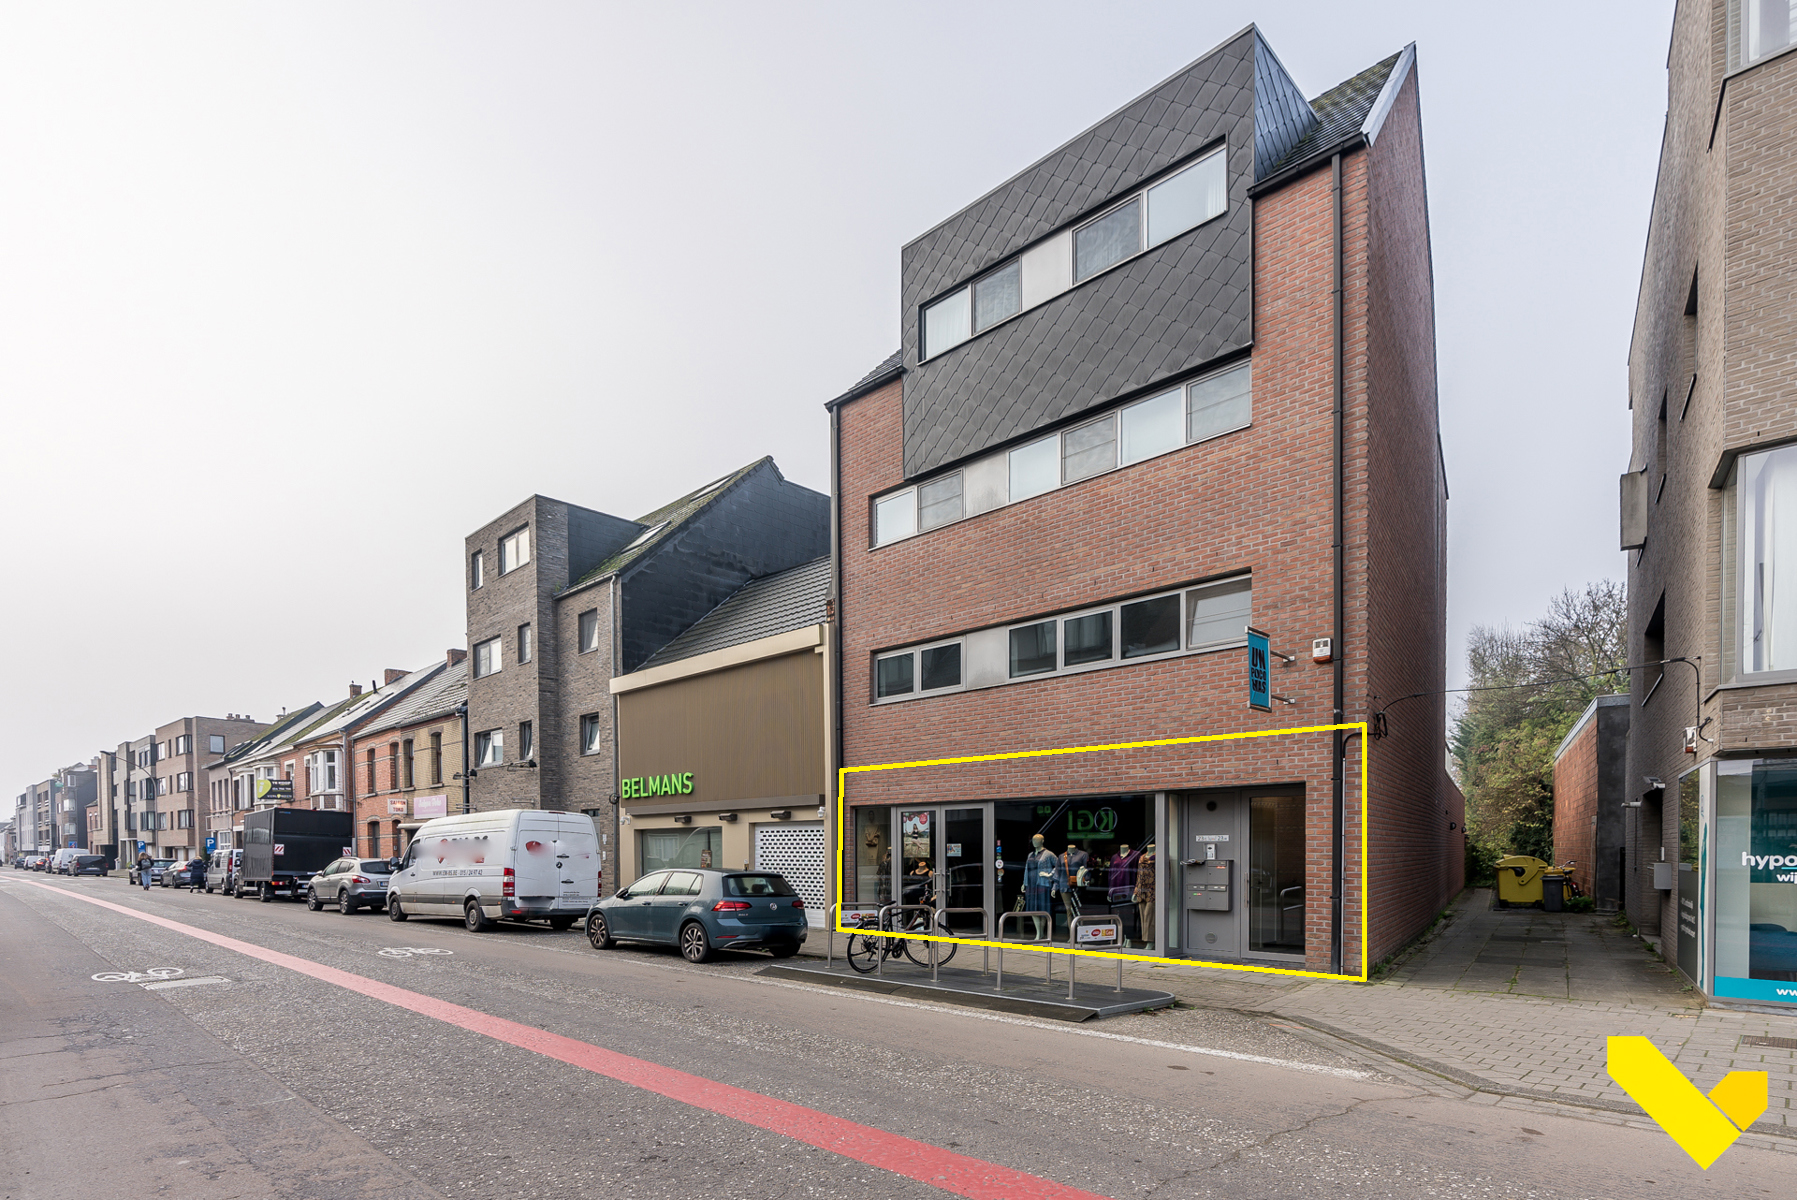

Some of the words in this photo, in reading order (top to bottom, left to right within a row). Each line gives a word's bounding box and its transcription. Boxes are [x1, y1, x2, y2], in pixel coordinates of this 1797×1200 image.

[1252, 647, 1265, 670] UN
[1251, 667, 1266, 681] POCO
[621, 772, 695, 799] BELMANS
[207, 839, 215, 847] P
[1741, 851, 1797, 870] hypo
